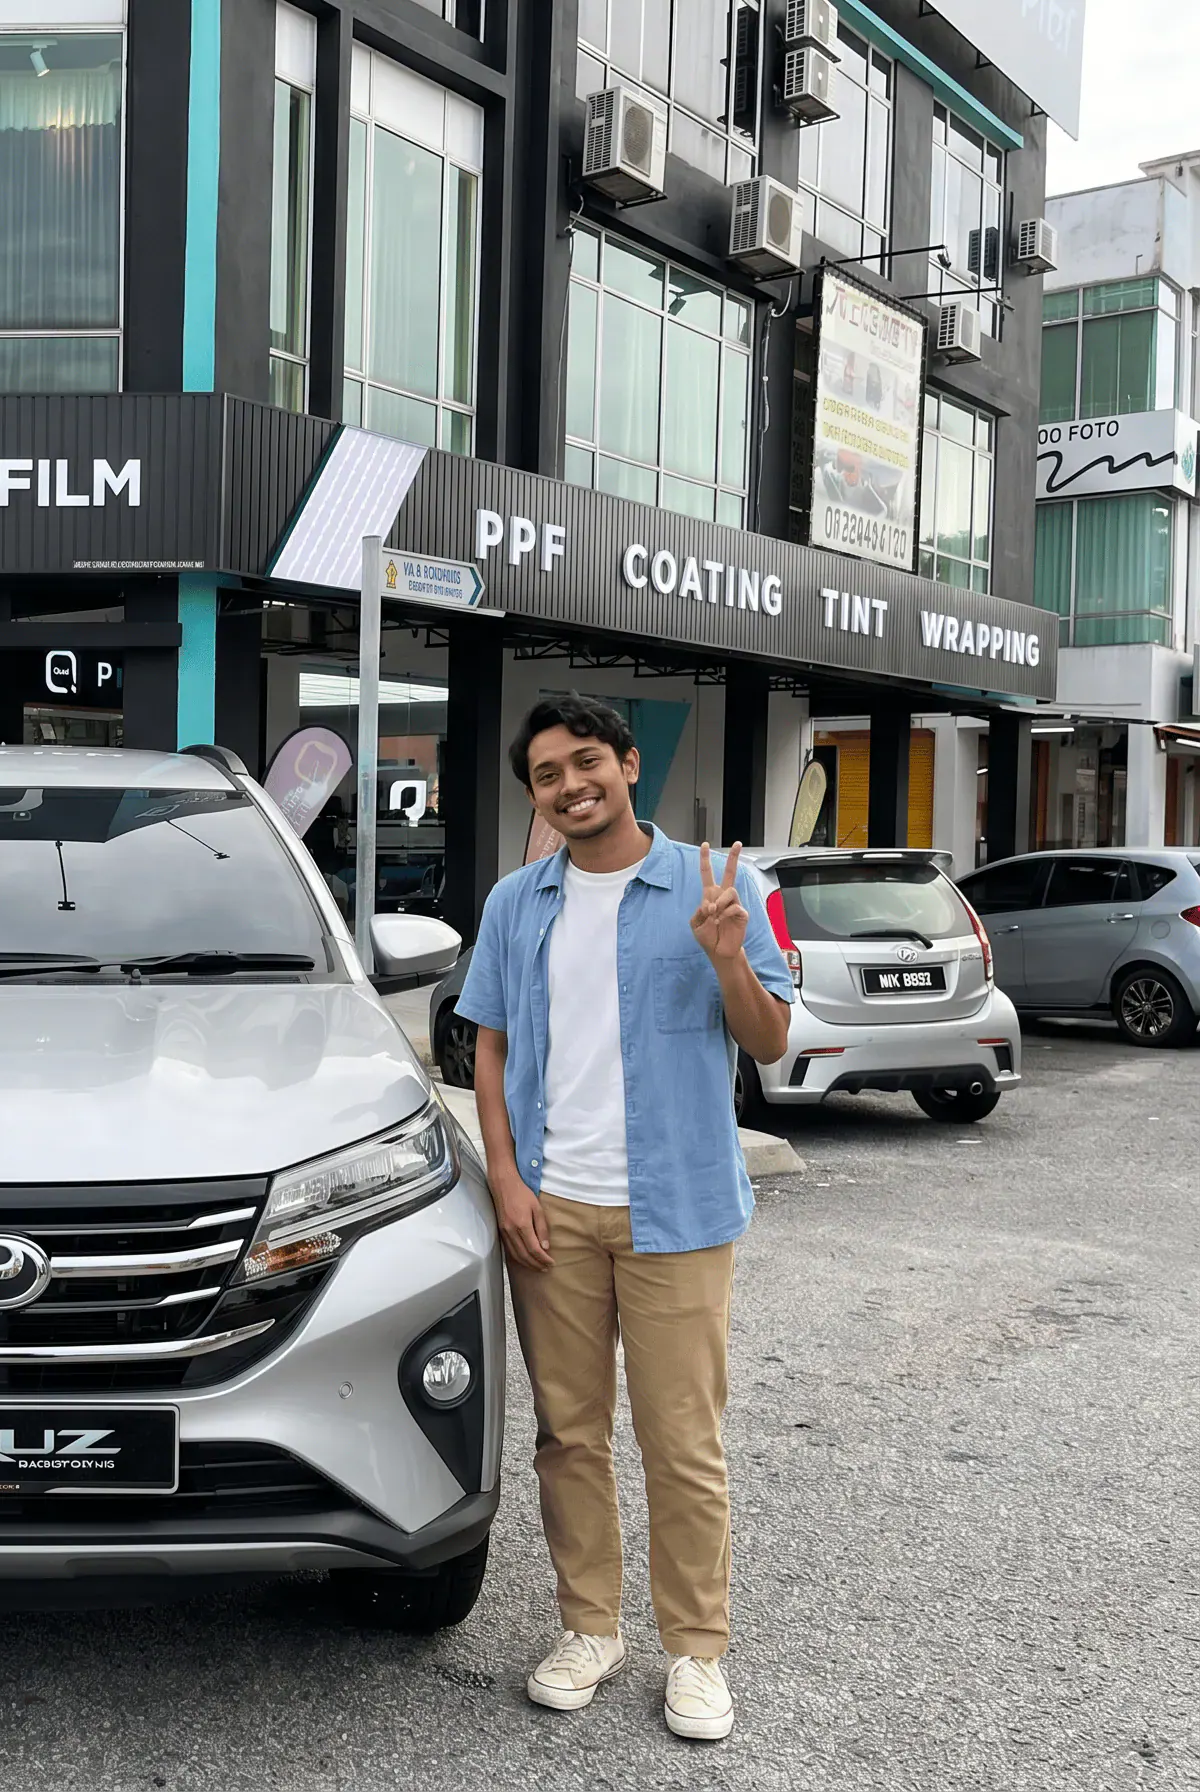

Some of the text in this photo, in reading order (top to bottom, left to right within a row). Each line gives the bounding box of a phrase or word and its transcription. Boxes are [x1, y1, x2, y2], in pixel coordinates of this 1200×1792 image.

[1069, 420, 1120, 441] FOTO
[474, 508, 1040, 667] PPF COATING TINT WRAPPING
